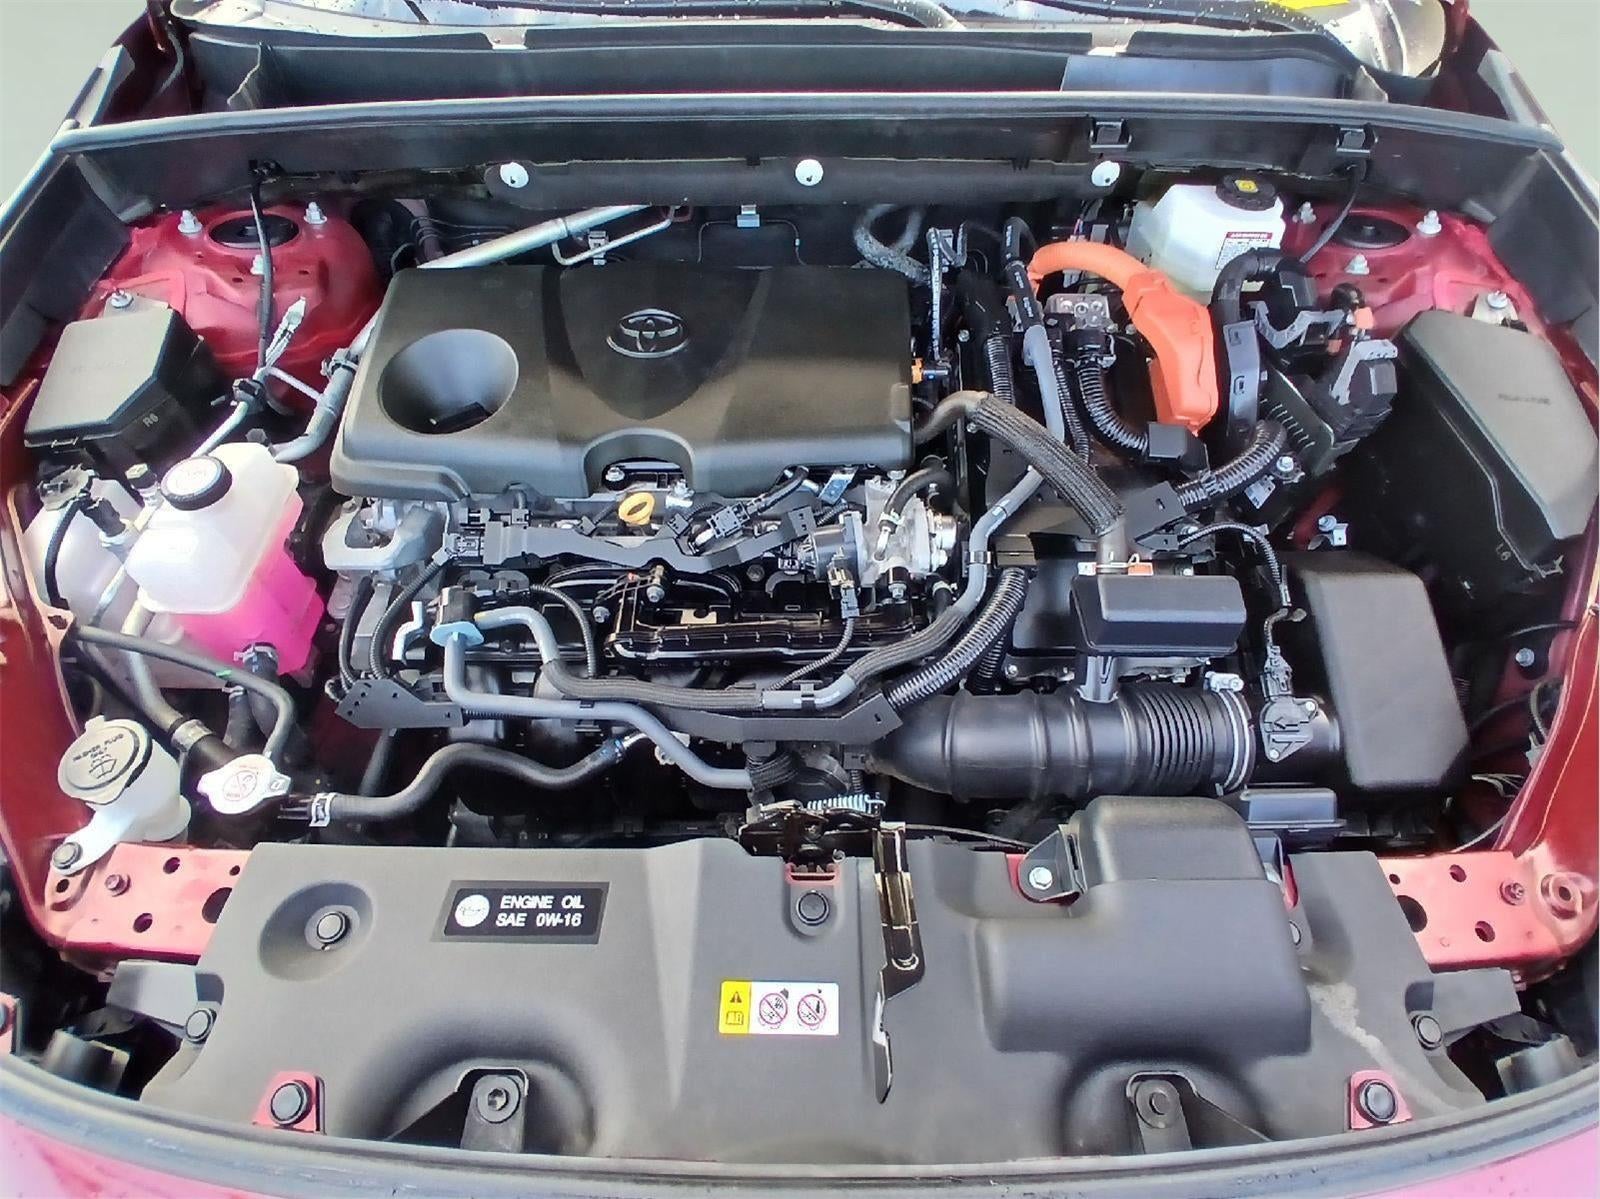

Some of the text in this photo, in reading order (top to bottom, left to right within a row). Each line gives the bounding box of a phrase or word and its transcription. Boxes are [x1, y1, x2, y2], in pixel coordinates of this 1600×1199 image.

[500, 895, 585, 909] ENGINE OIL
[495, 912, 582, 927] SAE 0W-16
